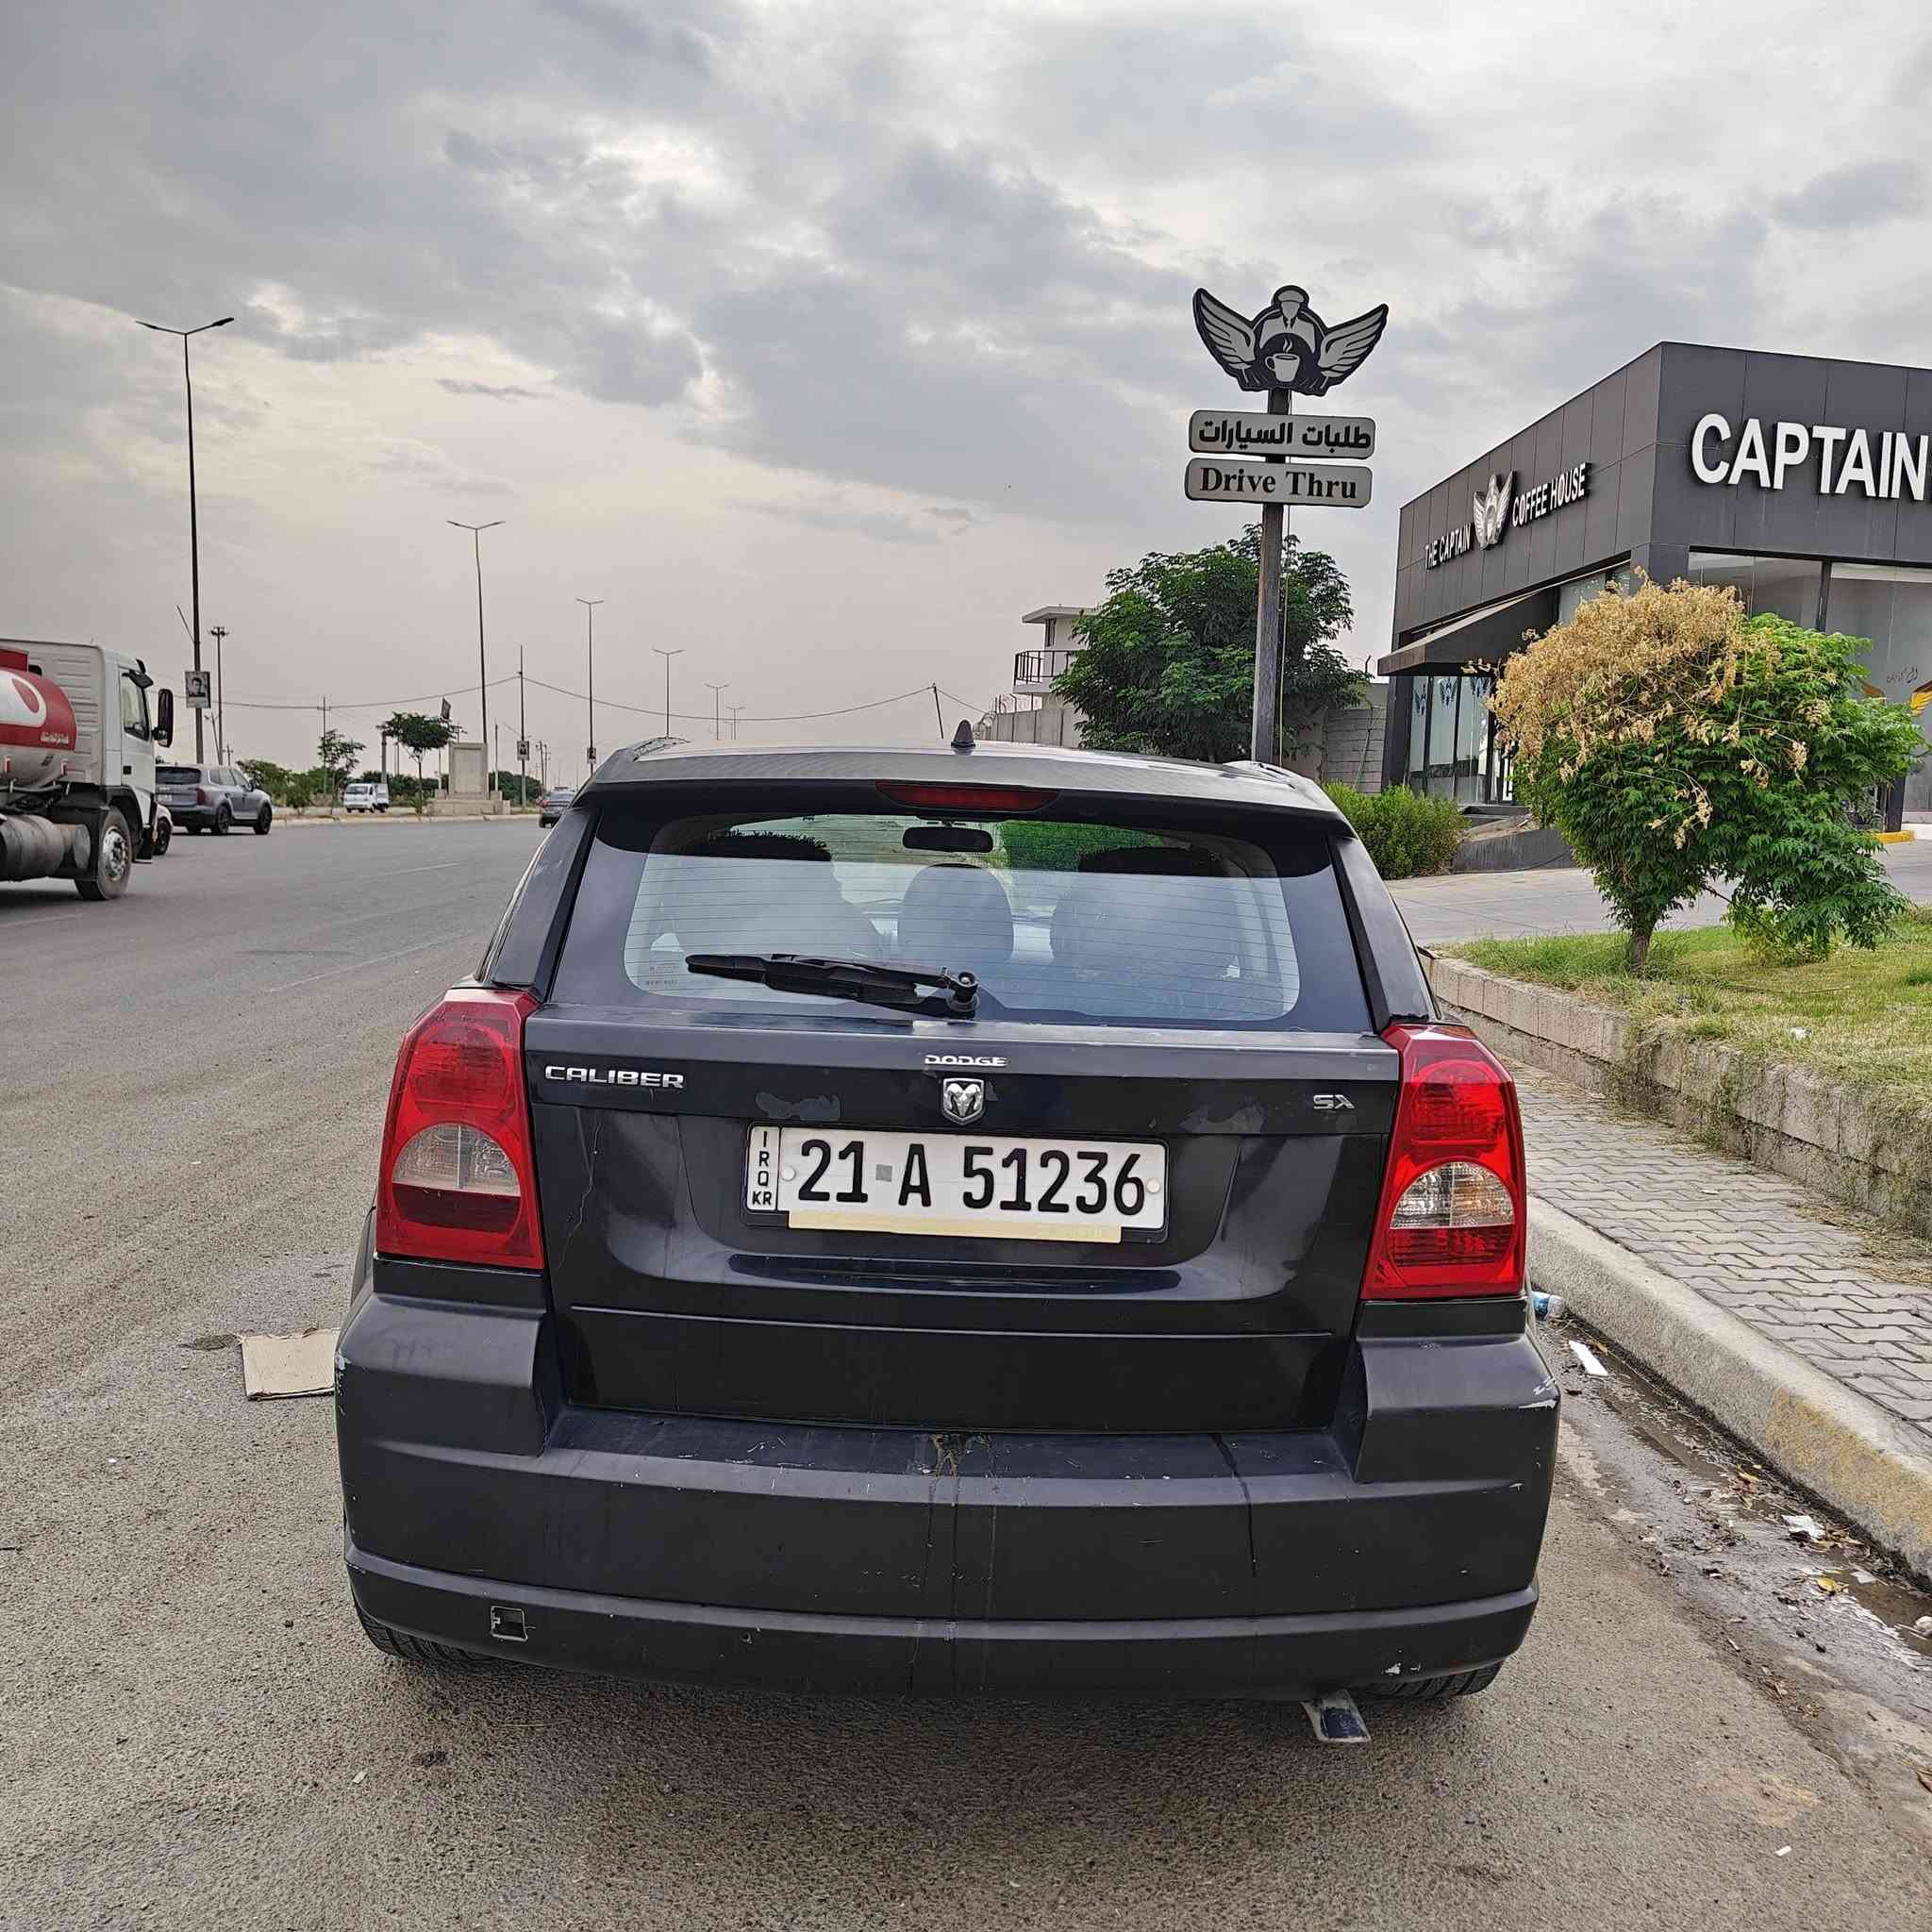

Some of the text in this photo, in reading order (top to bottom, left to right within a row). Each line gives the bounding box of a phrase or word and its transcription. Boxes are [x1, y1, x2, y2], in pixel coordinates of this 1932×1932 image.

[1198, 420, 1372, 453] طلبات السيارات
[1691, 413, 1929, 501] CAPTAIN
[1199, 466, 1357, 499] Drive Thru
[1424, 462, 1587, 571] THE CAPTAIN COFFEE HOUSE
[544, 1065, 685, 1089] CALIBER
[924, 1054, 1008, 1067] DODGE
[798, 1139, 1145, 1216] 21 A 51236
[752, 1191, 773, 1206] KR
